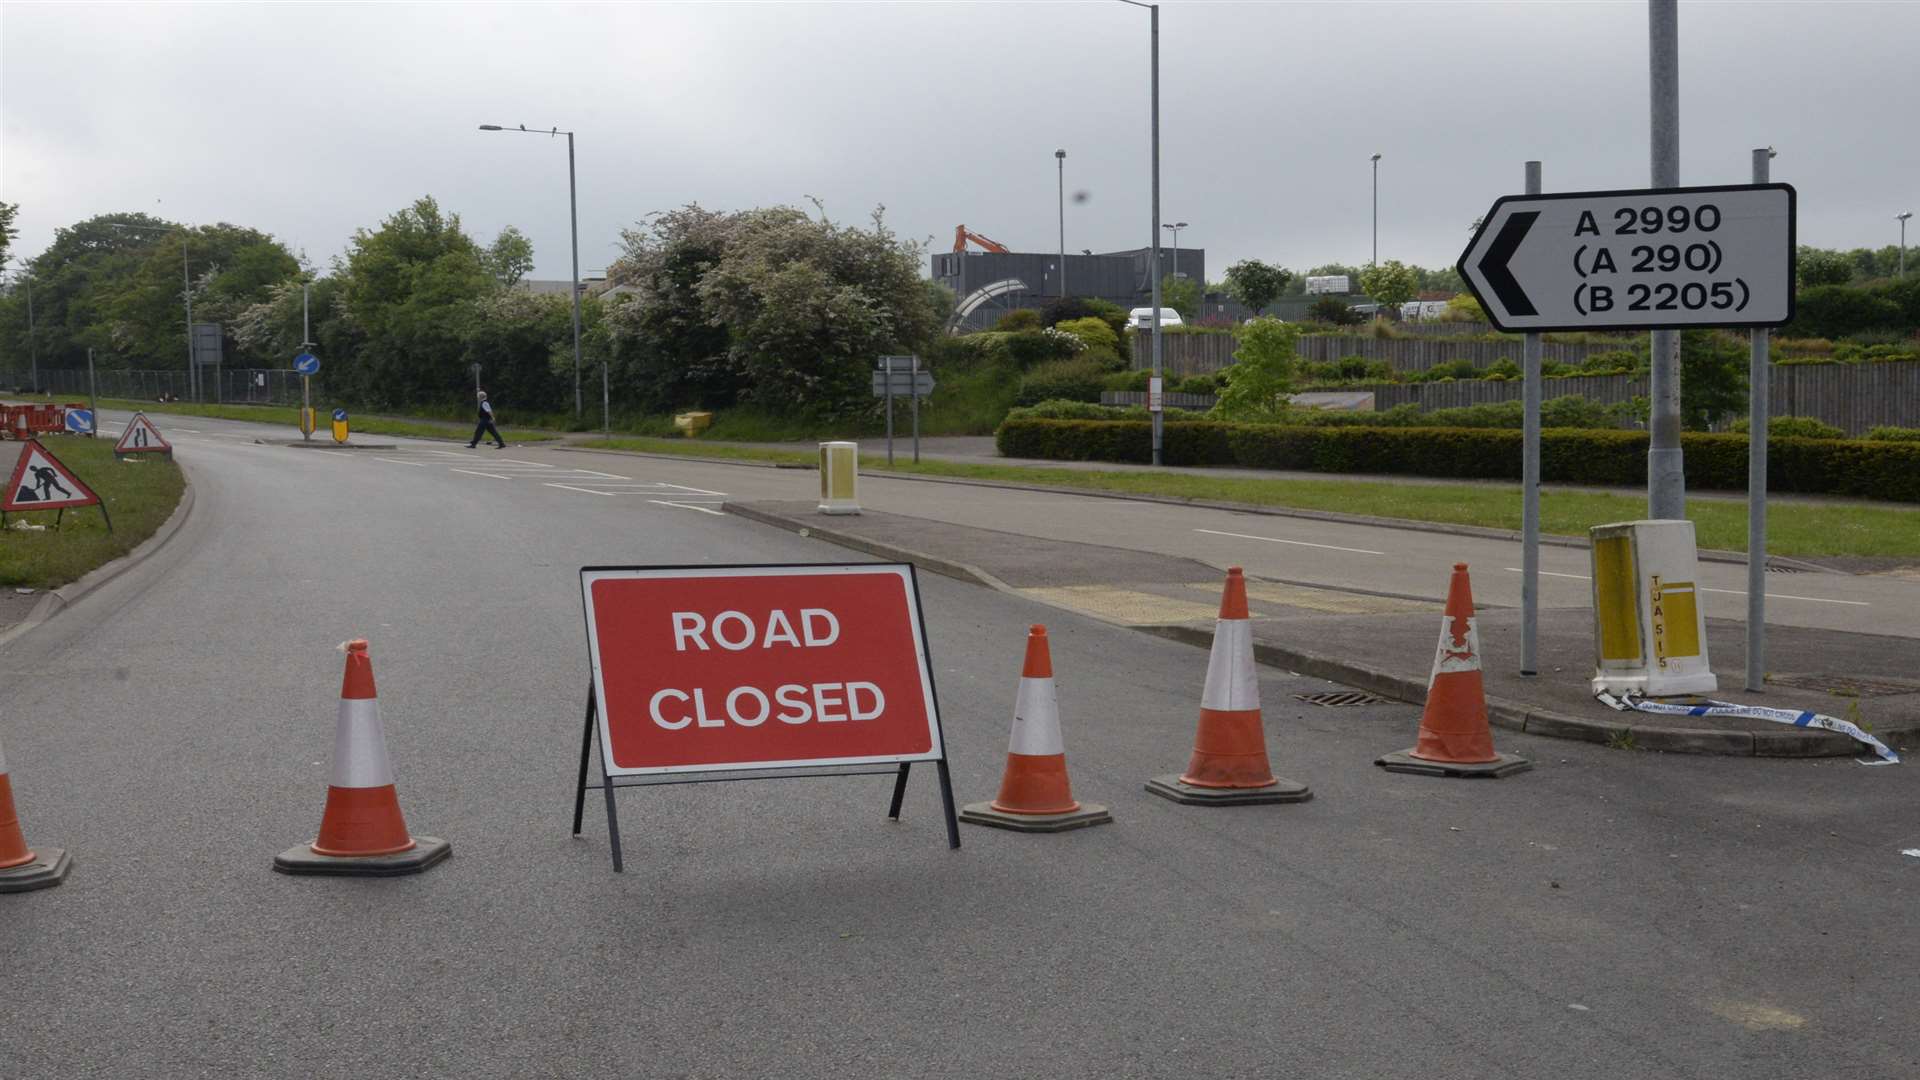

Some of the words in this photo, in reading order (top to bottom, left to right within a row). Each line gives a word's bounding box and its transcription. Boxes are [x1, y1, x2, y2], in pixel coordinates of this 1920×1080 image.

[1573, 209, 1601, 237] A
[1613, 204, 1722, 236] 2990
[1573, 244, 1618, 278] (A
[1630, 239, 1723, 275] 290)
[1573, 282, 1615, 316] (B
[1626, 277, 1751, 313] 2205)
[671, 608, 841, 651] ROAD
[649, 681, 886, 730] CLOSED
